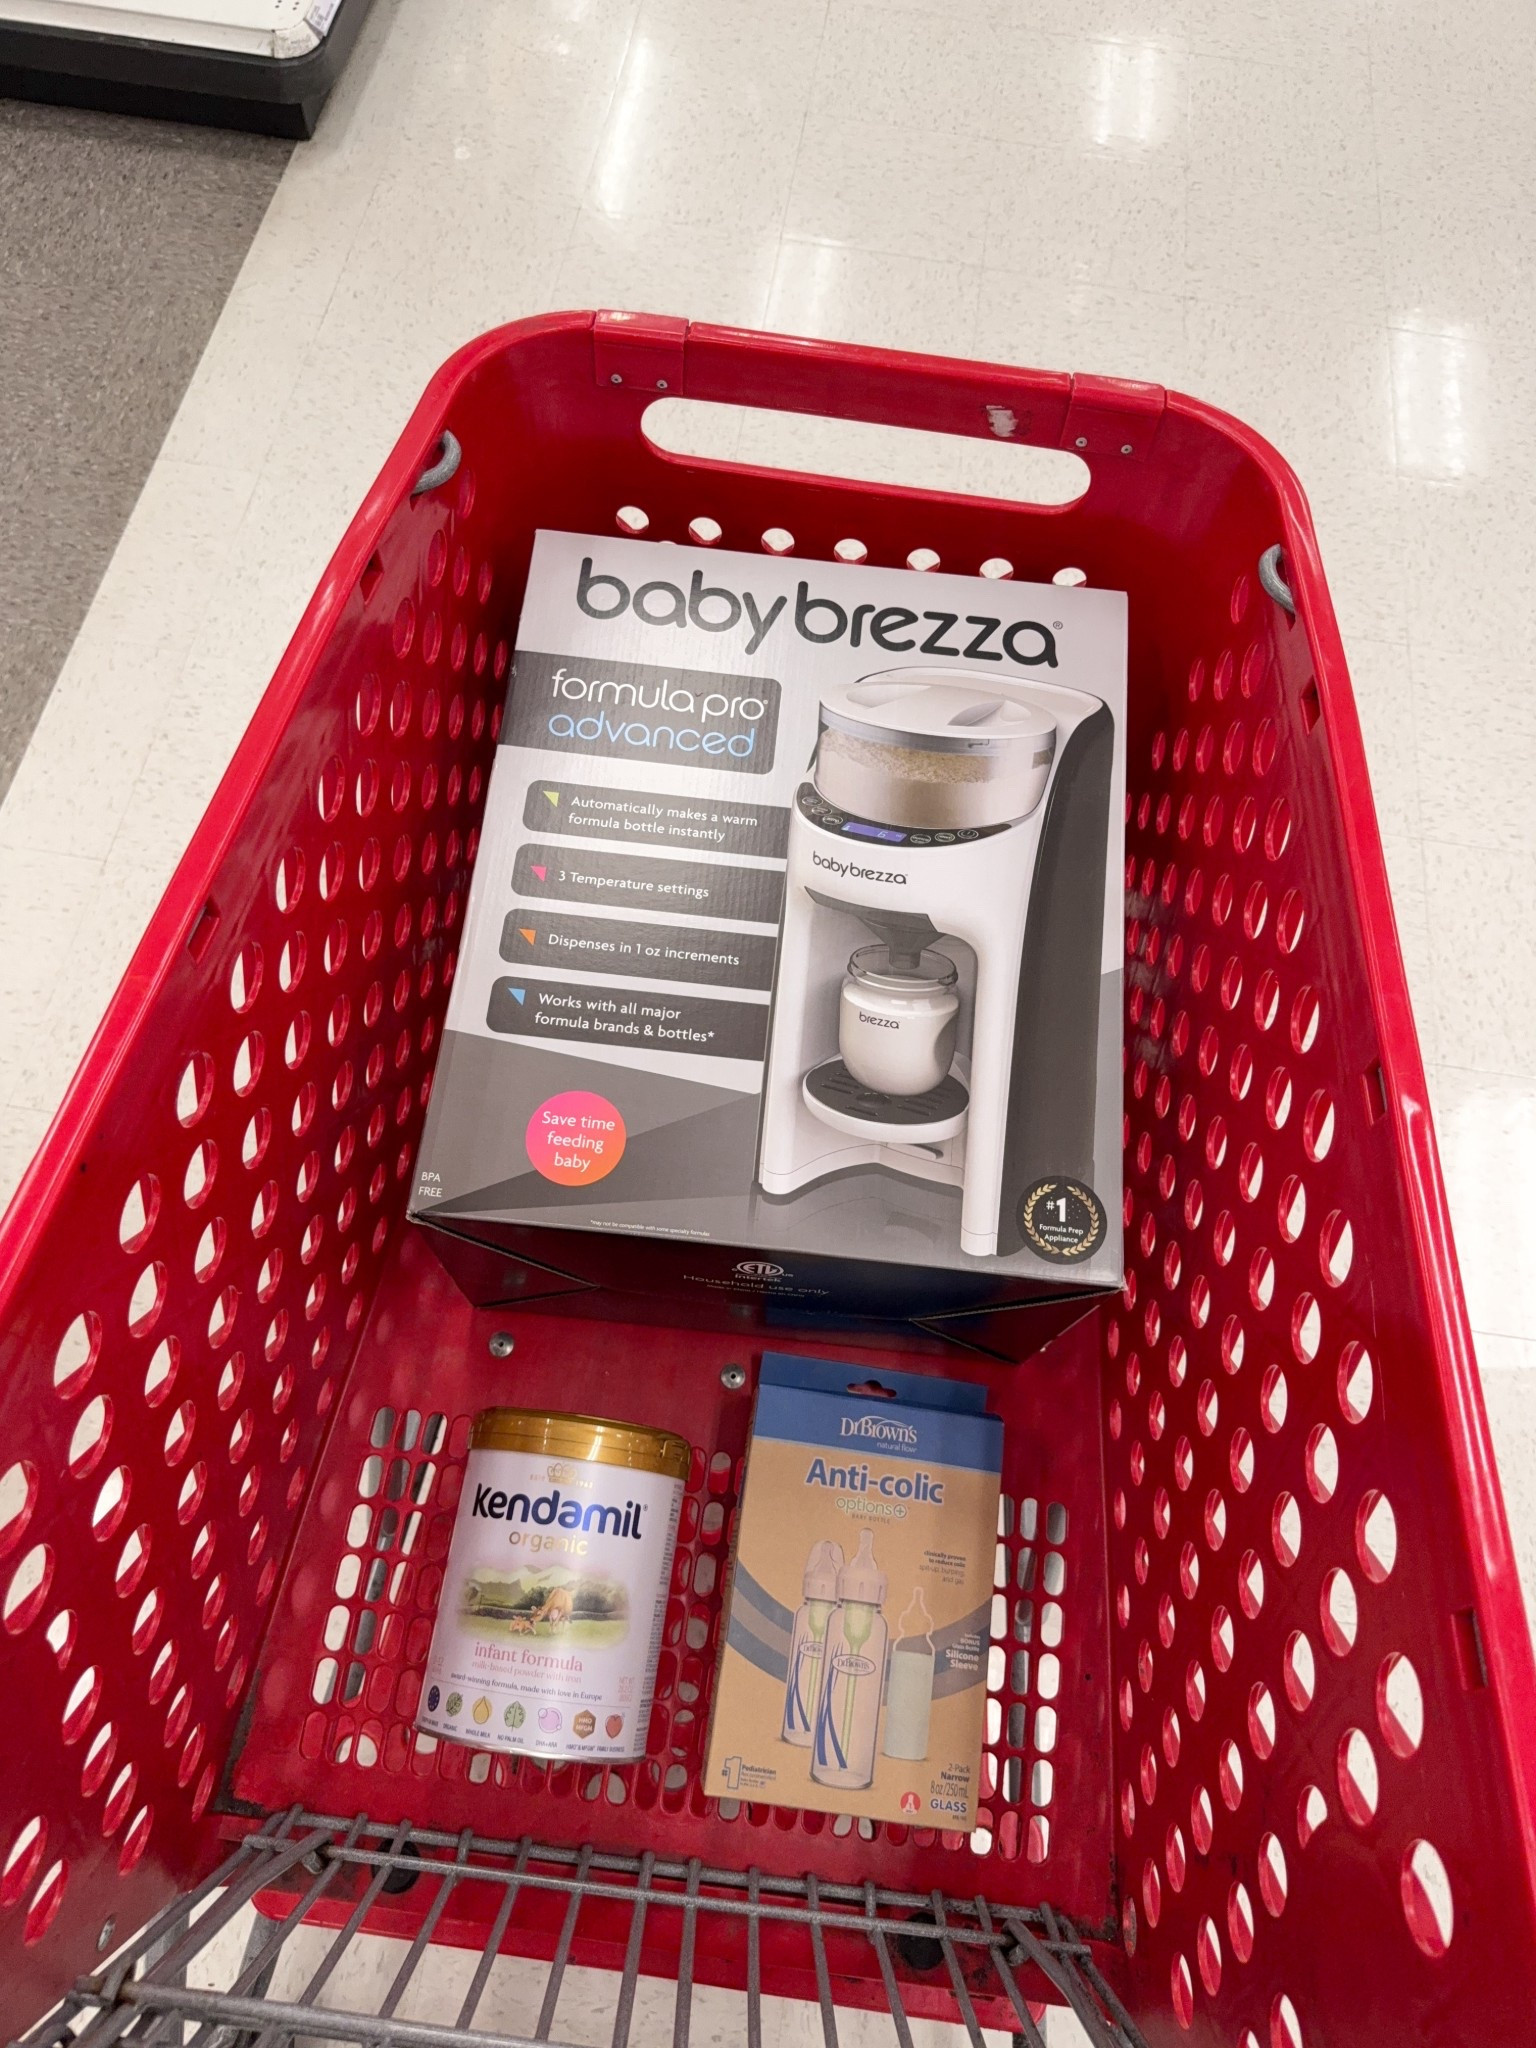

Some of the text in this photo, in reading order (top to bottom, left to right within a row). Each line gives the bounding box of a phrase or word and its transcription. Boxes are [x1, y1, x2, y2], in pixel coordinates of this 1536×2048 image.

[552, 668, 764, 723] formula pro
[549, 711, 755, 758] advanced
[571, 796, 758, 826] Automatically makes a warm
[568, 812, 725, 842] formula bottle instantly
[558, 871, 709, 900] 3 Temperature settings
[548, 934, 739, 965] Dispenses in 1 oz increments
[539, 993, 681, 1021] Works with all major
[535, 1012, 589, 1029] formula
[594, 1015, 639, 1034] brands
[644, 1025, 653, 1036] &
[859, 1011, 899, 1029] brezza
[542, 1111, 615, 1131] Save time
[547, 1131, 604, 1154] feeding
[554, 1152, 590, 1172] baby
[421, 1172, 440, 1182] BPA
[418, 1186, 442, 1197] FREE
[1039, 1224, 1084, 1236] Formula Prep
[1044, 1234, 1078, 1243] Appliance
[683, 1274, 764, 1289] Household
[876, 1442, 917, 1453] natural flow
[806, 1458, 943, 1503] Anti-colic
[472, 1483, 642, 1540] Kendamil
[509, 1531, 588, 1556] organic
[474, 1643, 582, 1672] infant formula
[945, 1648, 980, 1662] Silicone
[950, 1659, 979, 1671] Sleeve
[471, 1661, 581, 1683] milk-based powder with iron
[520, 1685, 540, 1693] made
[541, 1687, 556, 1695] with
[557, 1688, 571, 1697] love
[581, 1692, 602, 1701] Europe
[465, 1728, 479, 1737] WHOLE
[941, 1771, 970, 1783] Narrow
[948, 1763, 971, 1774] 2-Pack
[930, 1780, 936, 1794] 8
[930, 1798, 967, 1813] GLASS
